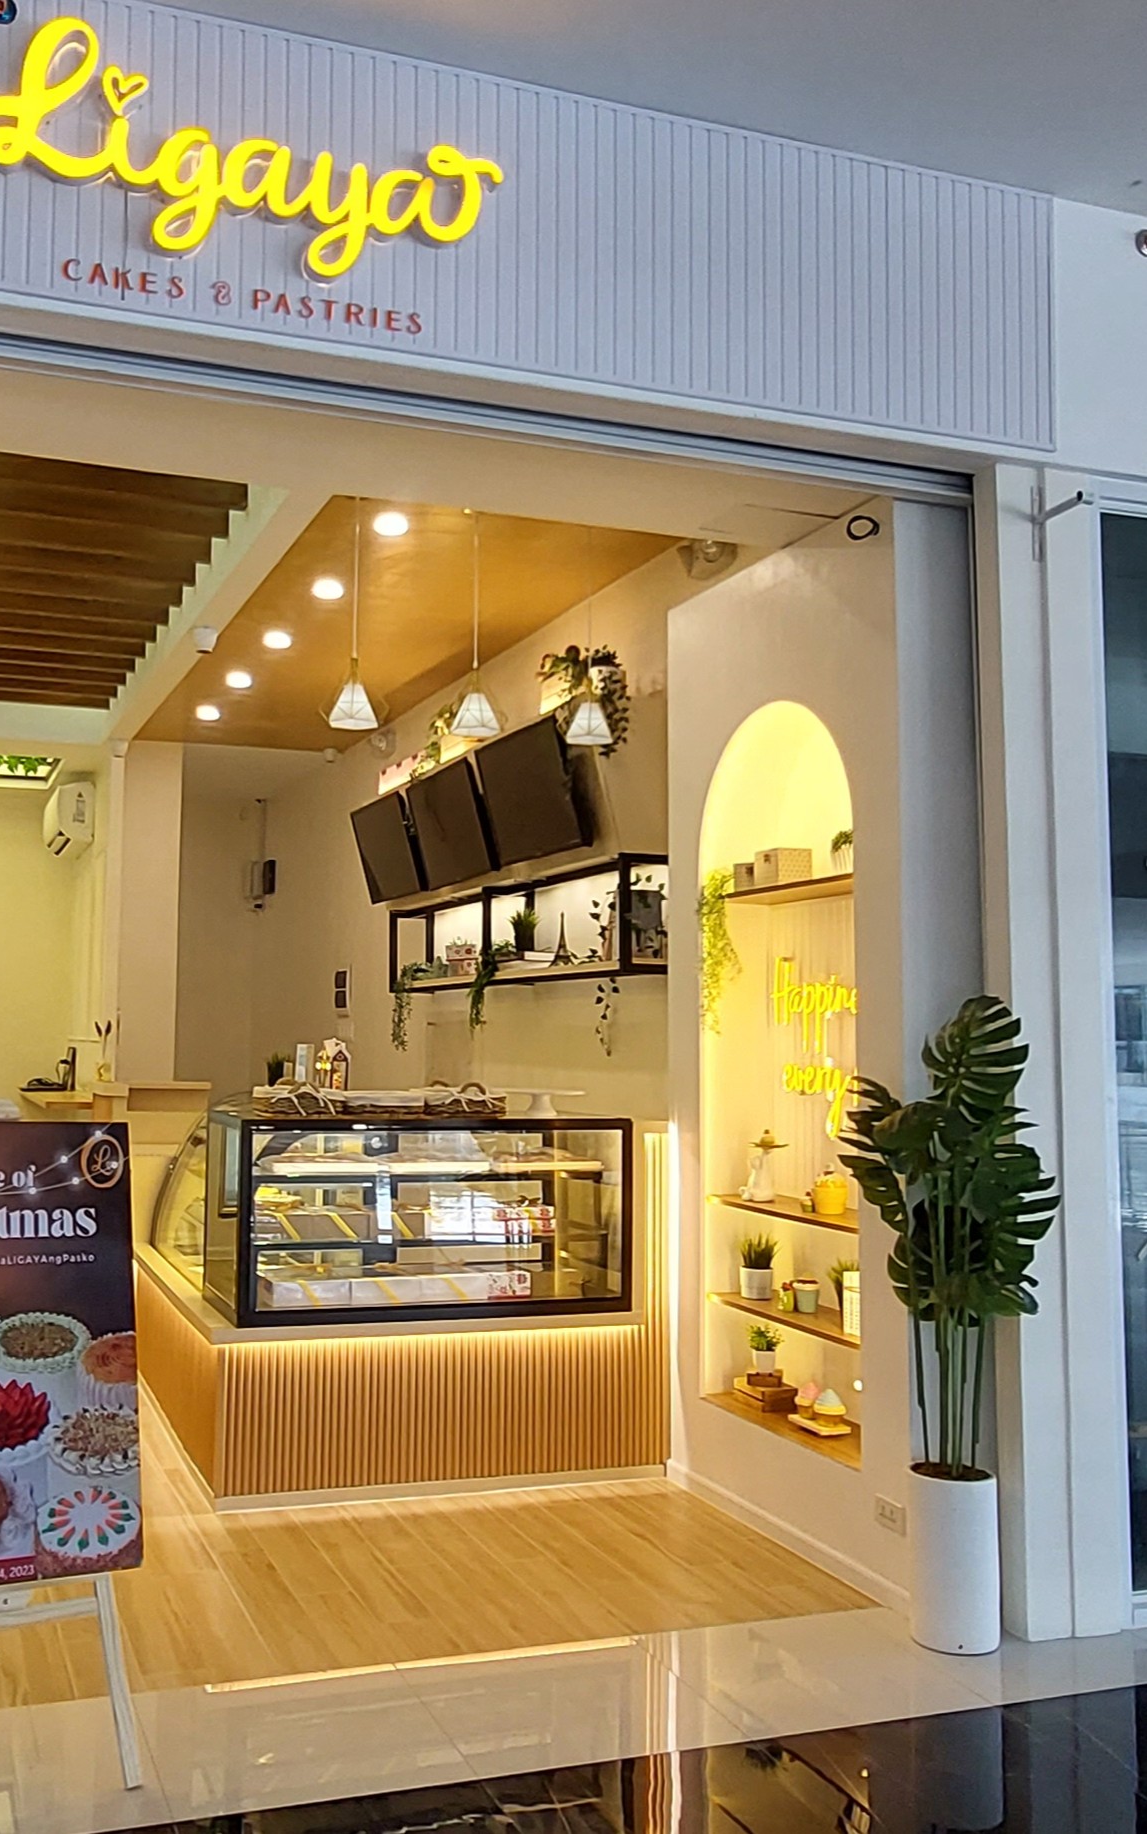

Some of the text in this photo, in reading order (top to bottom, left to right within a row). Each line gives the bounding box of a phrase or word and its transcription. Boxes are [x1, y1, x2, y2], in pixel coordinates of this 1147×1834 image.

[61, 258, 185, 299] CAKES
[253, 288, 423, 335] PASTRIES
[12, 1164, 37, 1188] of
[9, 1564, 35, 1578] 2023
